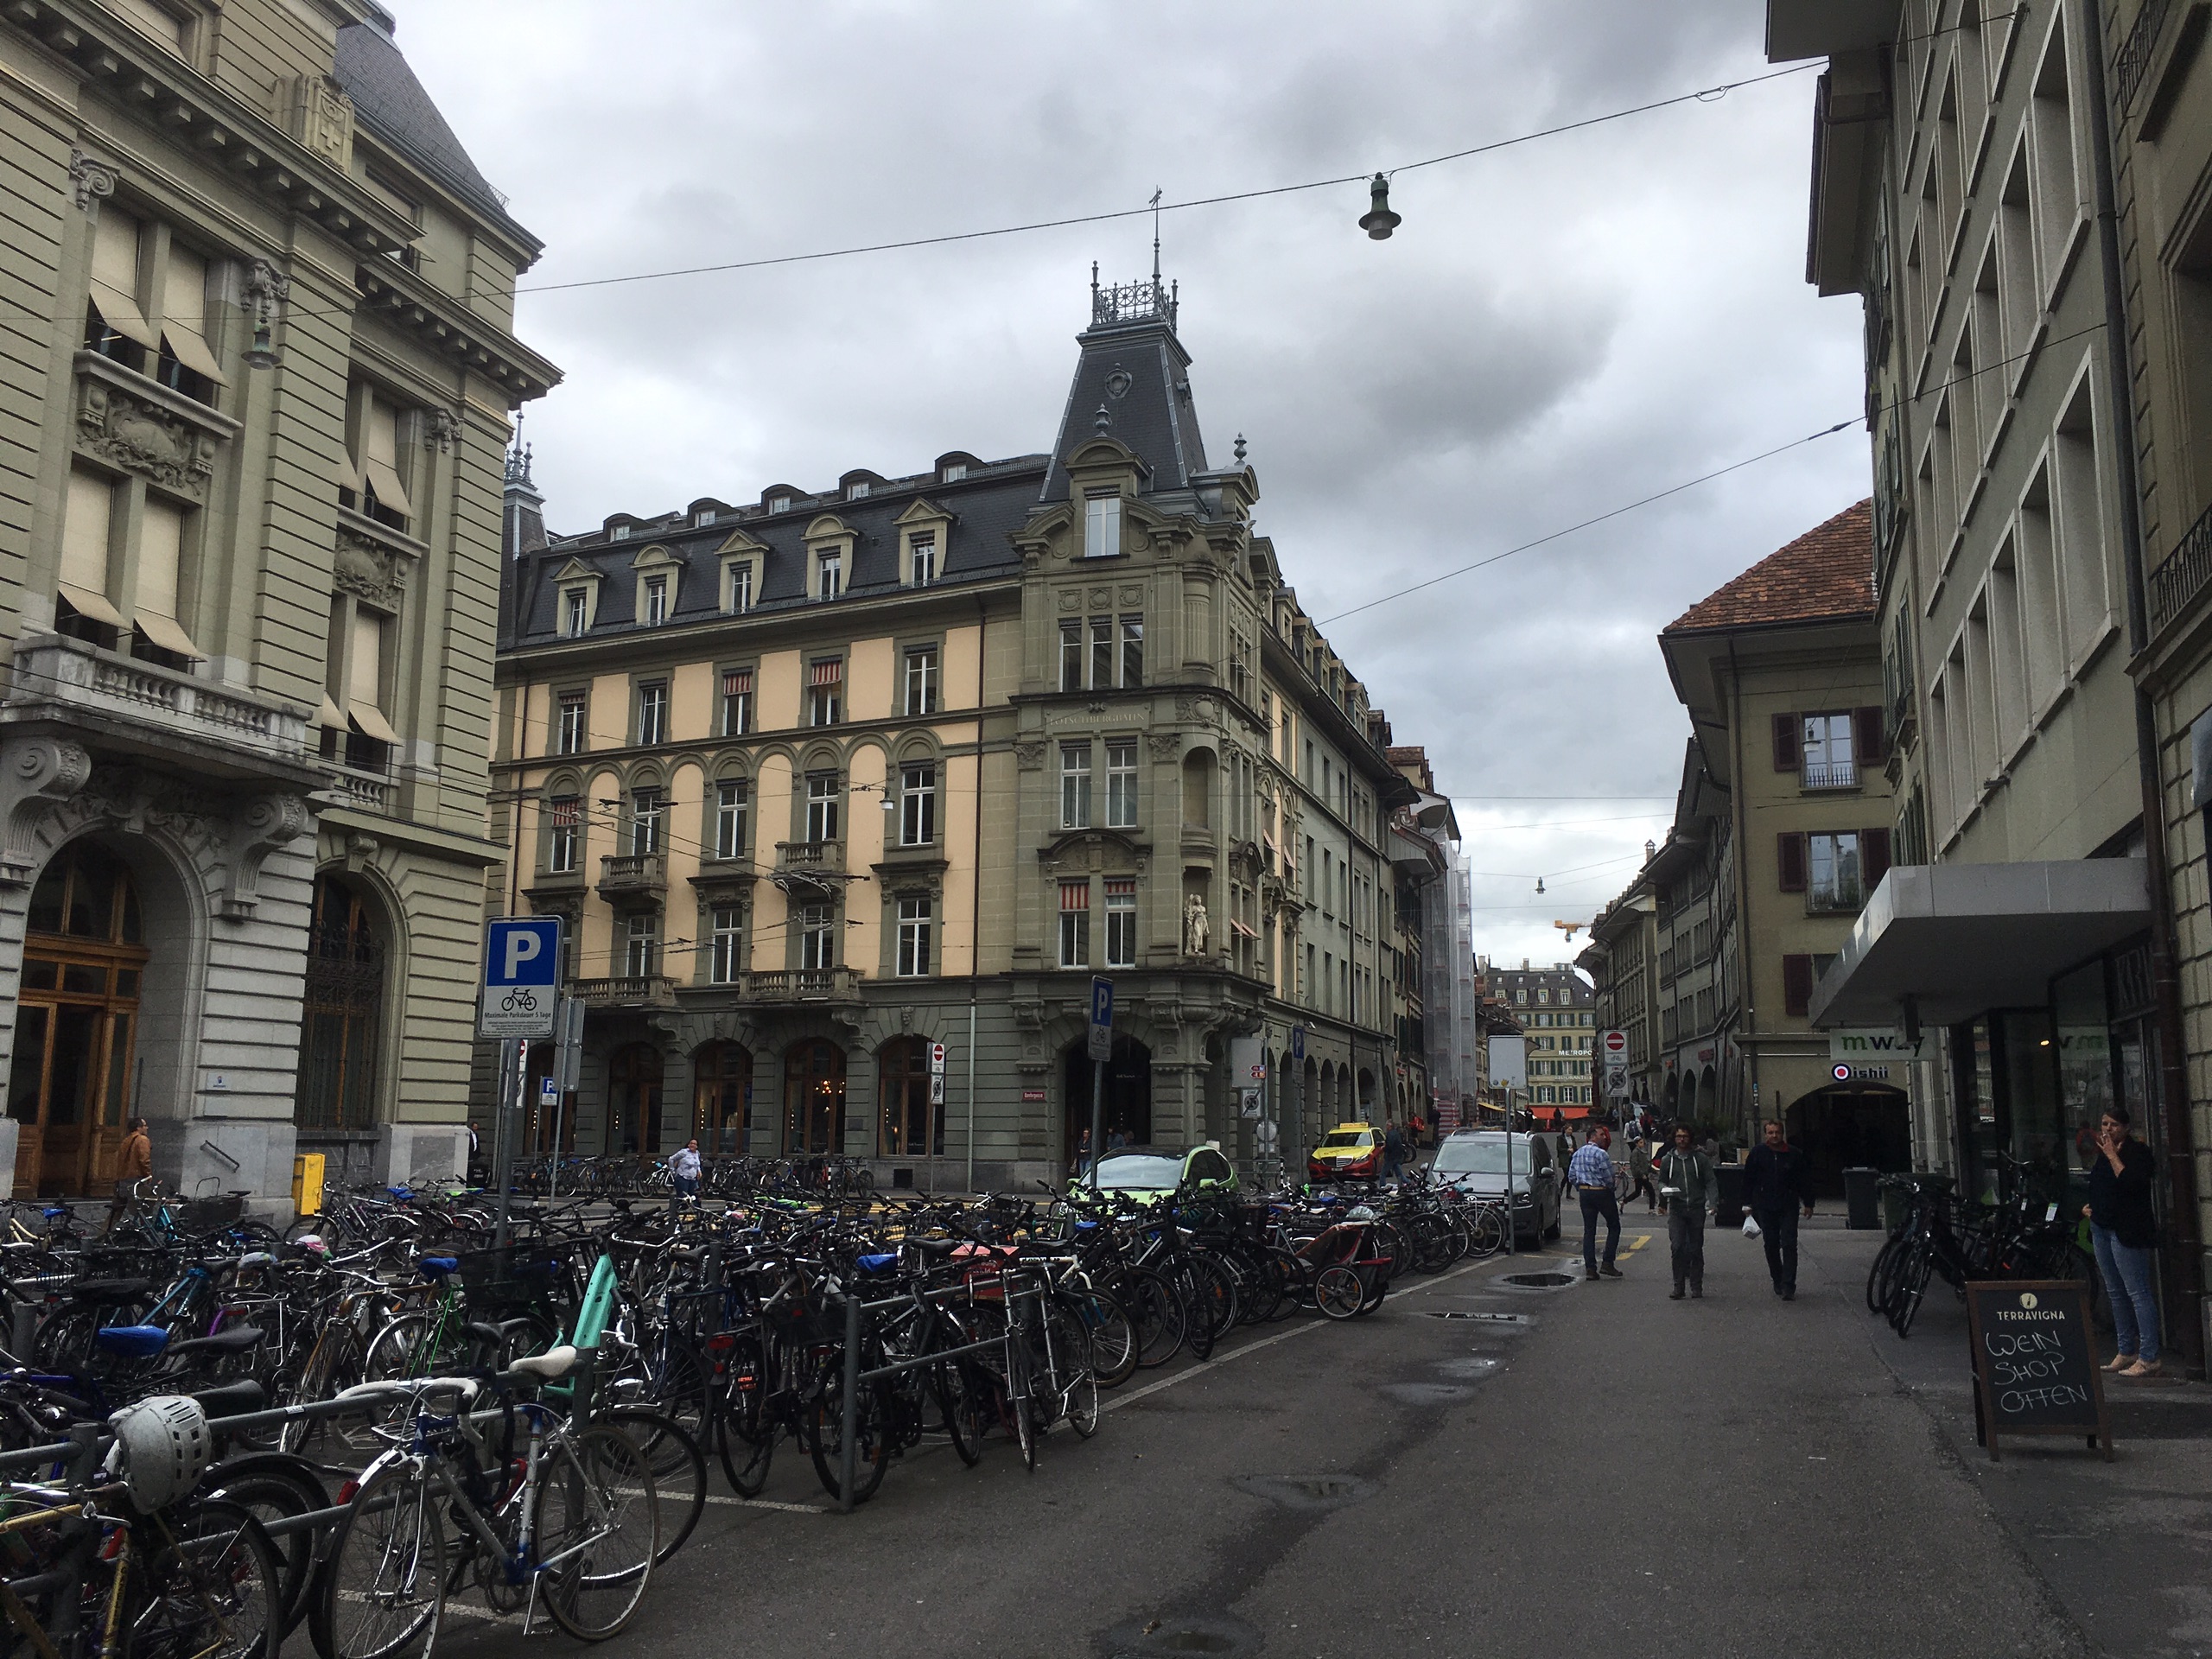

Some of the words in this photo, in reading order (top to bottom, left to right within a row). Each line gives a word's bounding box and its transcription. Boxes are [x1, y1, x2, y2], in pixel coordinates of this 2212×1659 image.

[504, 931, 542, 979] P
[1097, 987, 1108, 1020] P
[1296, 1032, 1301, 1055] P
[546, 1080, 554, 1092] P
[1997, 1311, 2065, 1320] TERRAVIGNA
[1986, 1331, 2062, 1357] WEIN
[1994, 1351, 2065, 1385] SHOP
[2001, 1384, 2088, 1413] OFFEN
